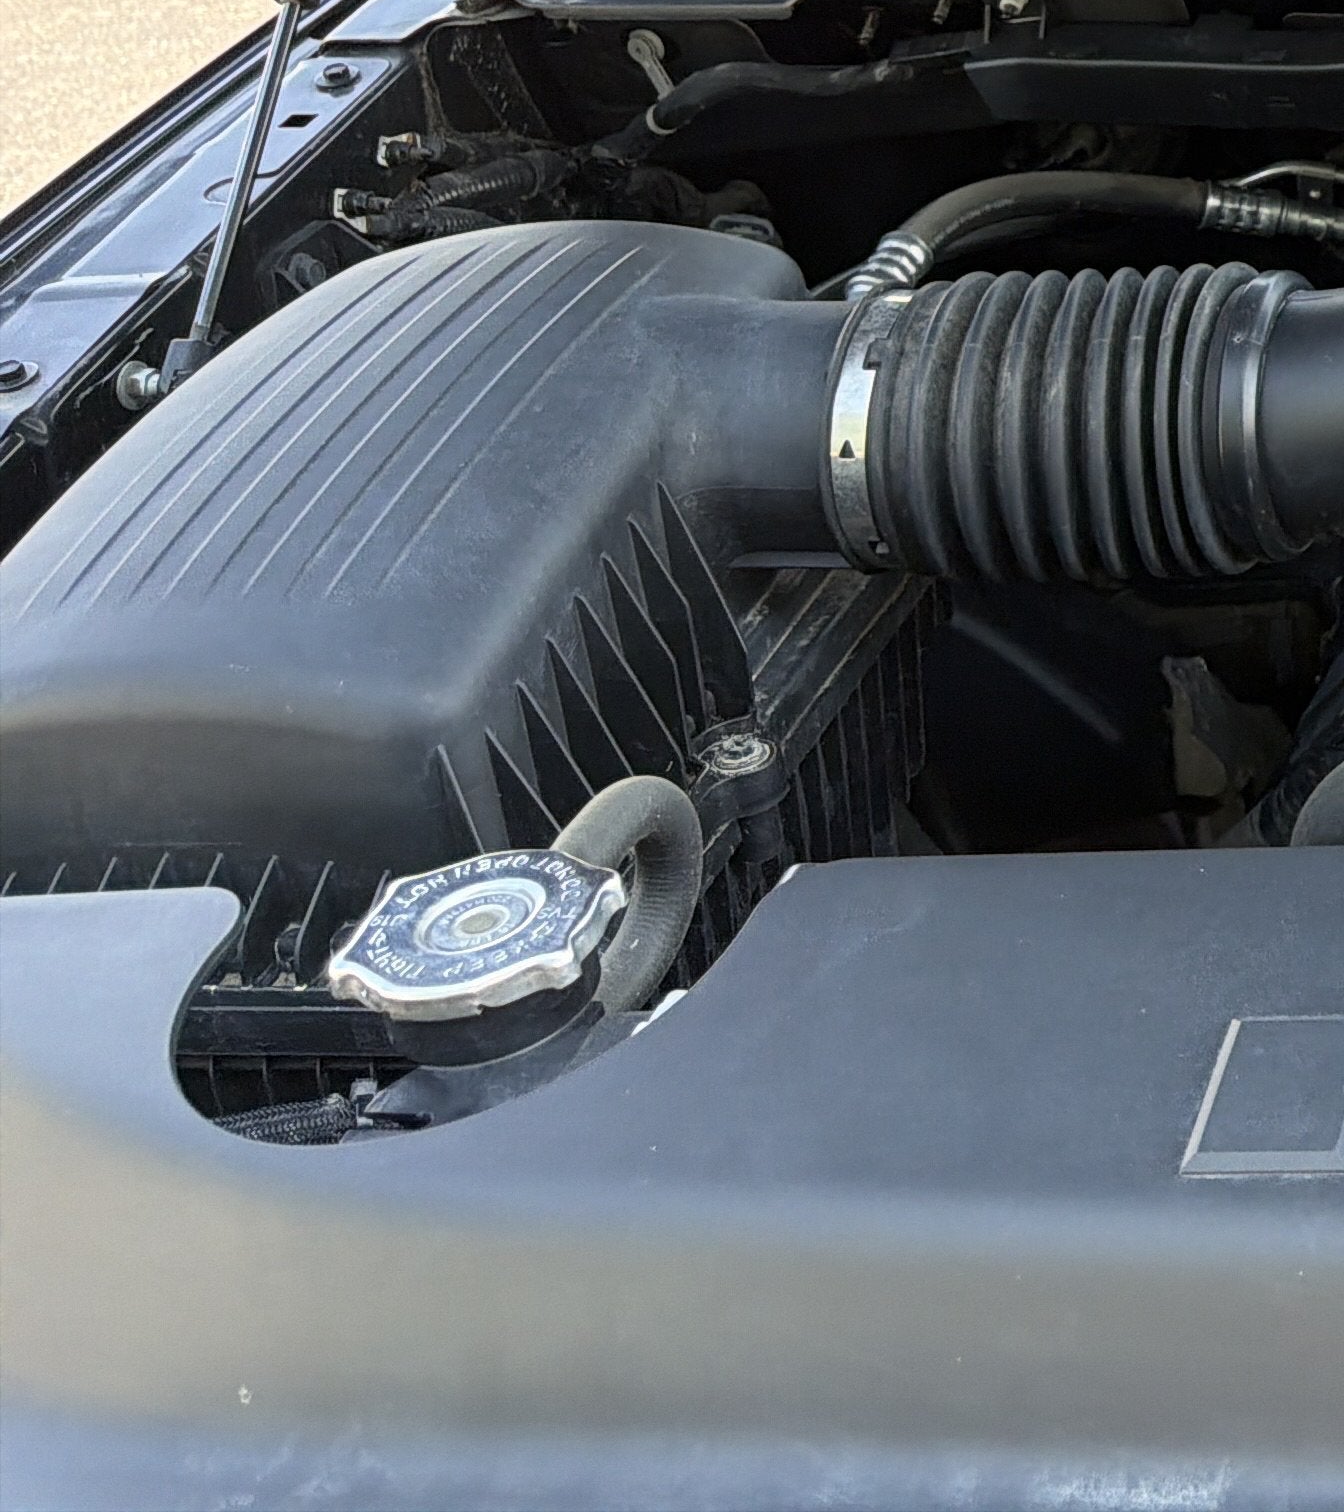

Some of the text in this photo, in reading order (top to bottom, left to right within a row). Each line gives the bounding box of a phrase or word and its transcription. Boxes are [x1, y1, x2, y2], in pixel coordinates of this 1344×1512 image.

[454, 854, 530, 879] OPEN
[394, 873, 448, 908] HOT
[536, 906, 577, 919] TVS
